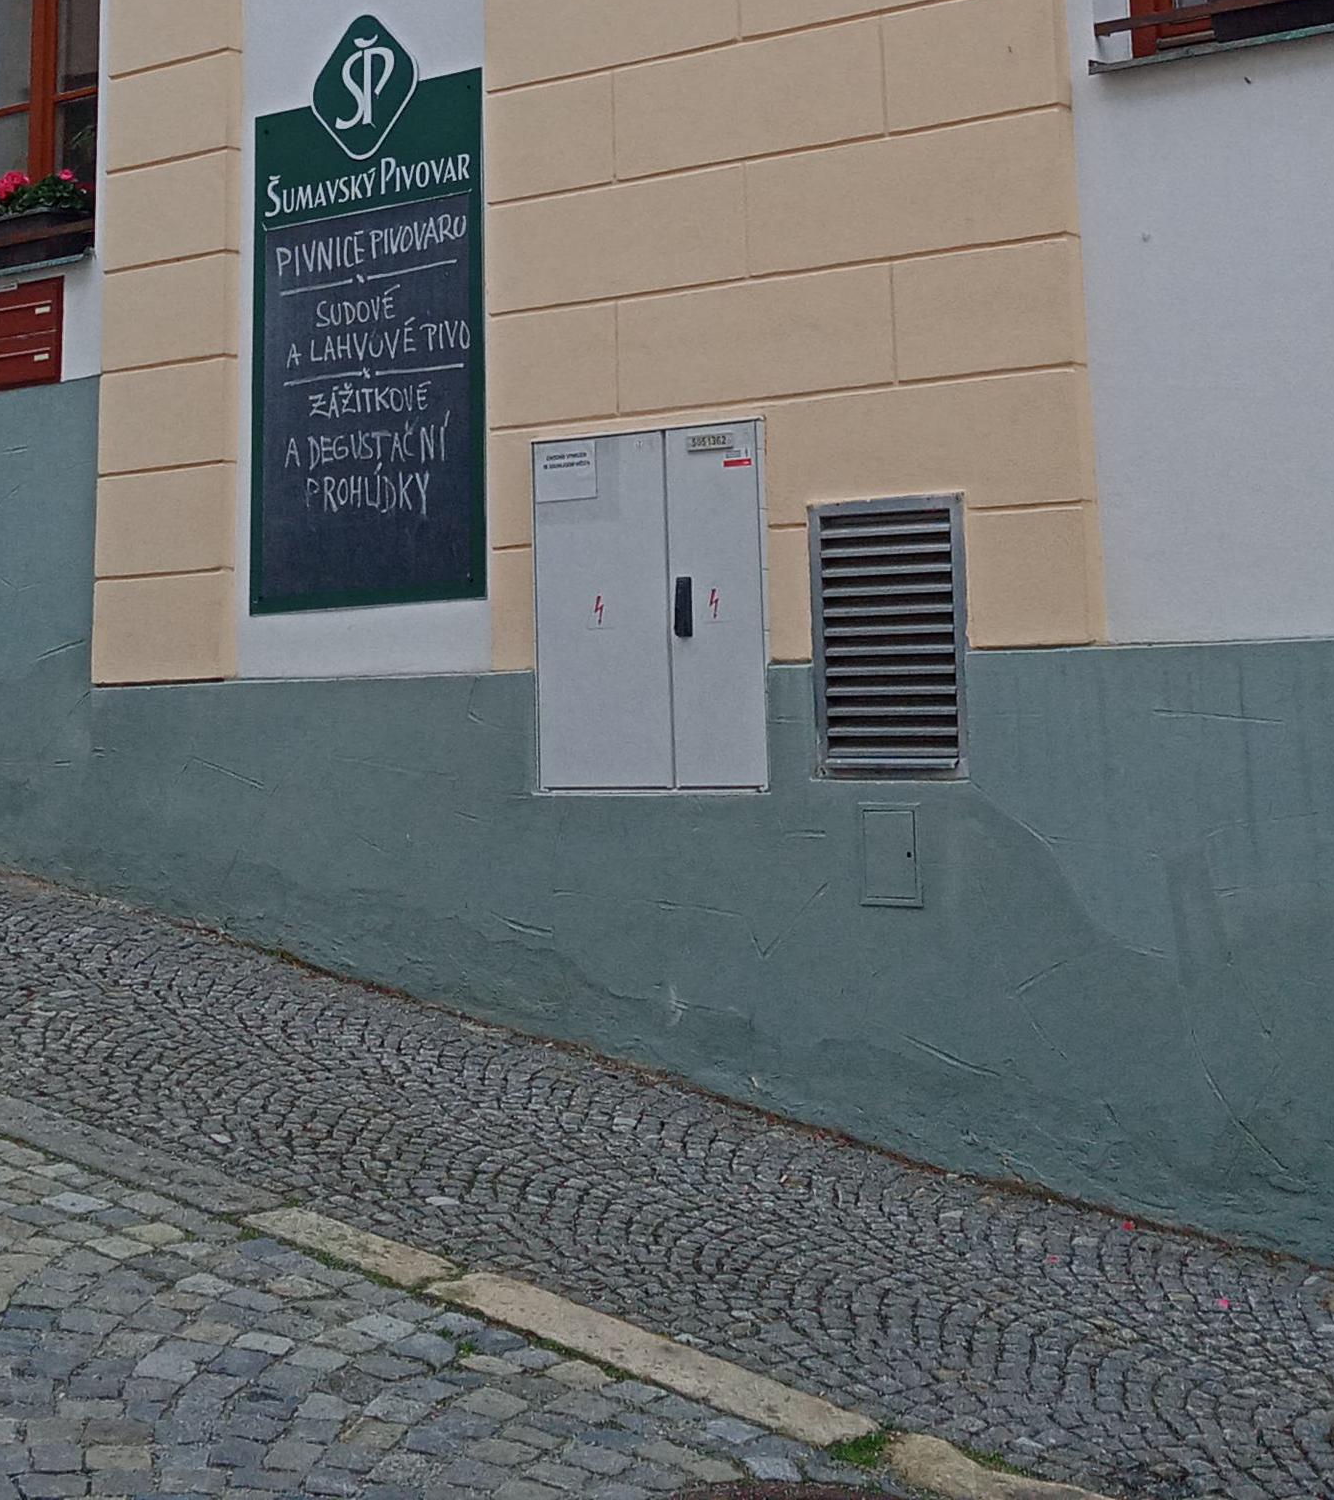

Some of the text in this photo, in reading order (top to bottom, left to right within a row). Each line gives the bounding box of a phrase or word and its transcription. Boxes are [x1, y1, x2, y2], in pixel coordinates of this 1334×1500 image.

[264, 153, 471, 218] ŠUMAVSKÝ PIVOVAR
[369, 213, 467, 260] PIVOVARU
[315, 284, 401, 328] SUDOVÉ
[285, 316, 471, 369] A LAHVOVÉ PIVO
[308, 380, 432, 419] ZÁŽITKOVÉ
[284, 437, 301, 469] A
[305, 461, 430, 516] PROHLÍDKY
